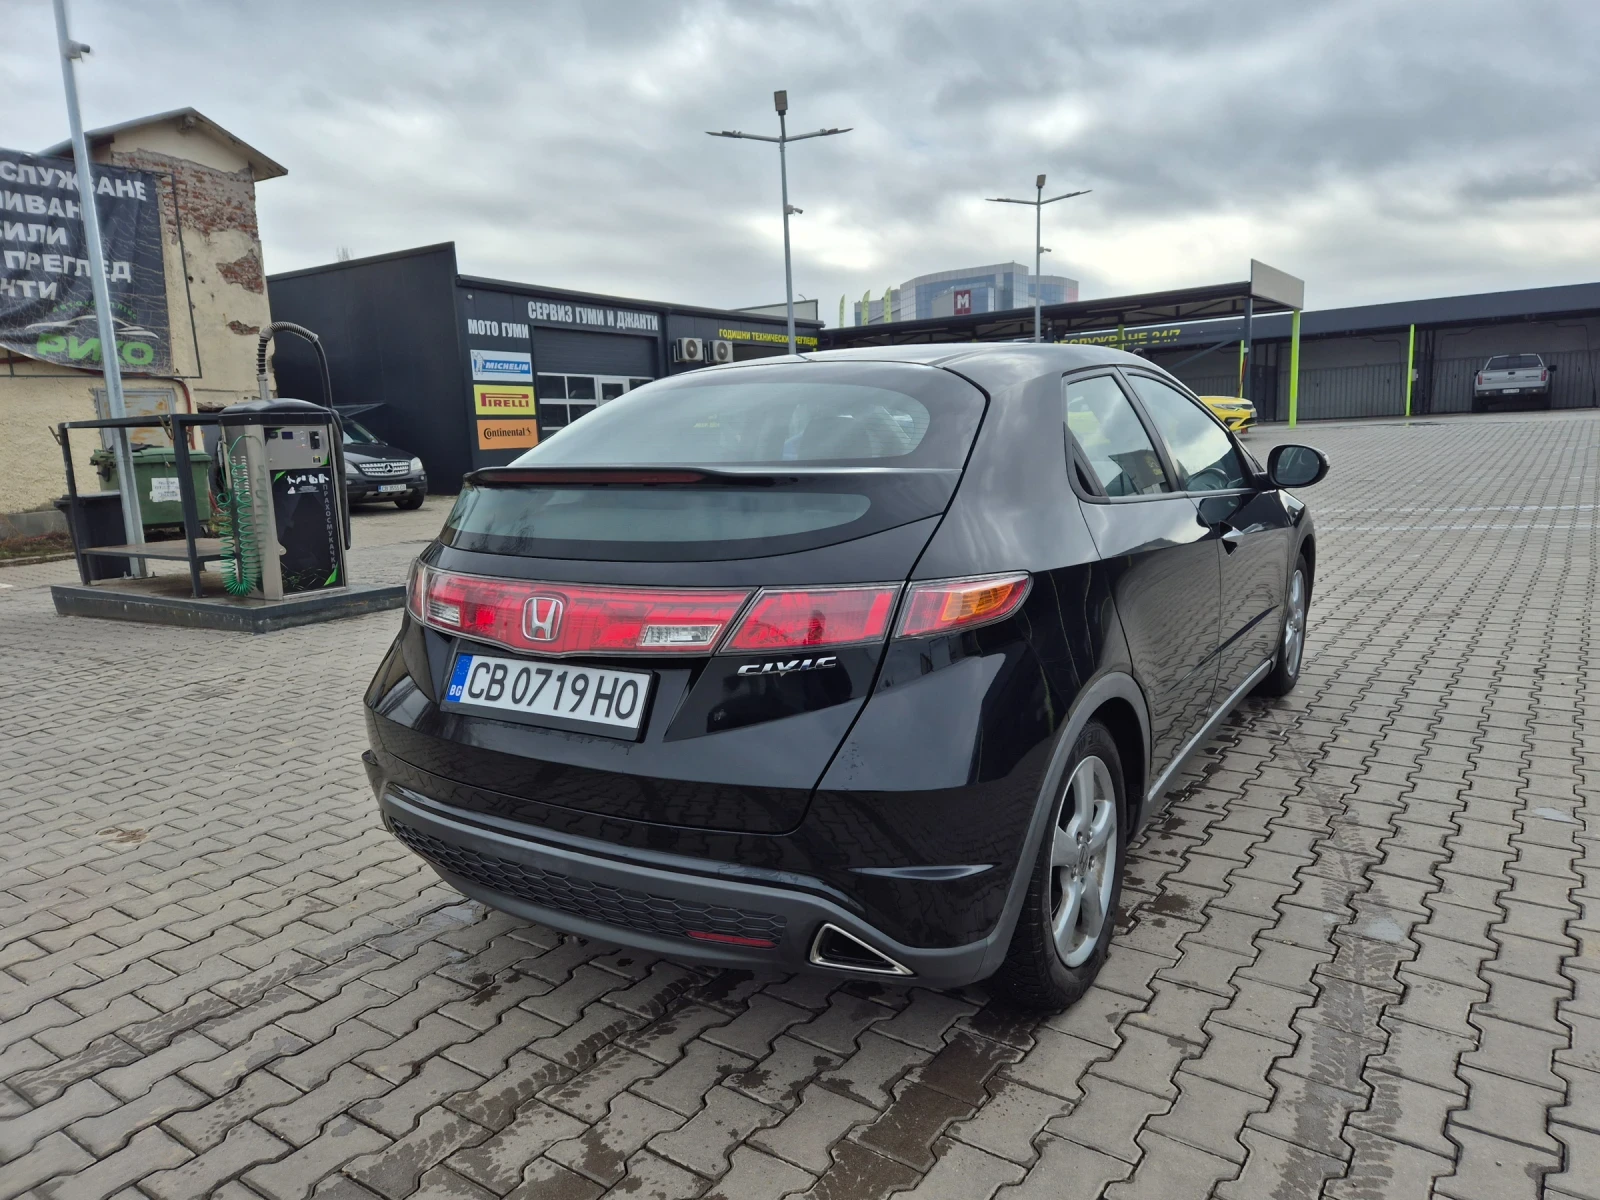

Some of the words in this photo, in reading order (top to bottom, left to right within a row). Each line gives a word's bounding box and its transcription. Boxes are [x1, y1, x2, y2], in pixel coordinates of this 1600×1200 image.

[0, 161, 147, 201] СЛУЖАНЕ
[0, 190, 82, 219] ИВАН
[0, 220, 67, 245] ИЛИ
[527, 301, 573, 323] СЕРВИЗ
[575, 306, 605, 326] ГУМИ
[606, 309, 615, 327] И
[616, 310, 659, 331] ДЖАНТИ
[467, 319, 499, 337] МОТО
[501, 322, 529, 339] ГУМИ
[719, 328, 751, 340] ГОДИШНИ
[485, 361, 529, 371] MICHELIN
[480, 392, 529, 407] PIRELLI
[483, 427, 526, 440] Continental
[322, 484, 337, 569] ПРАХОСМУКАЧКА
[737, 656, 837, 677] CIVIC
[449, 684, 463, 697] BG
